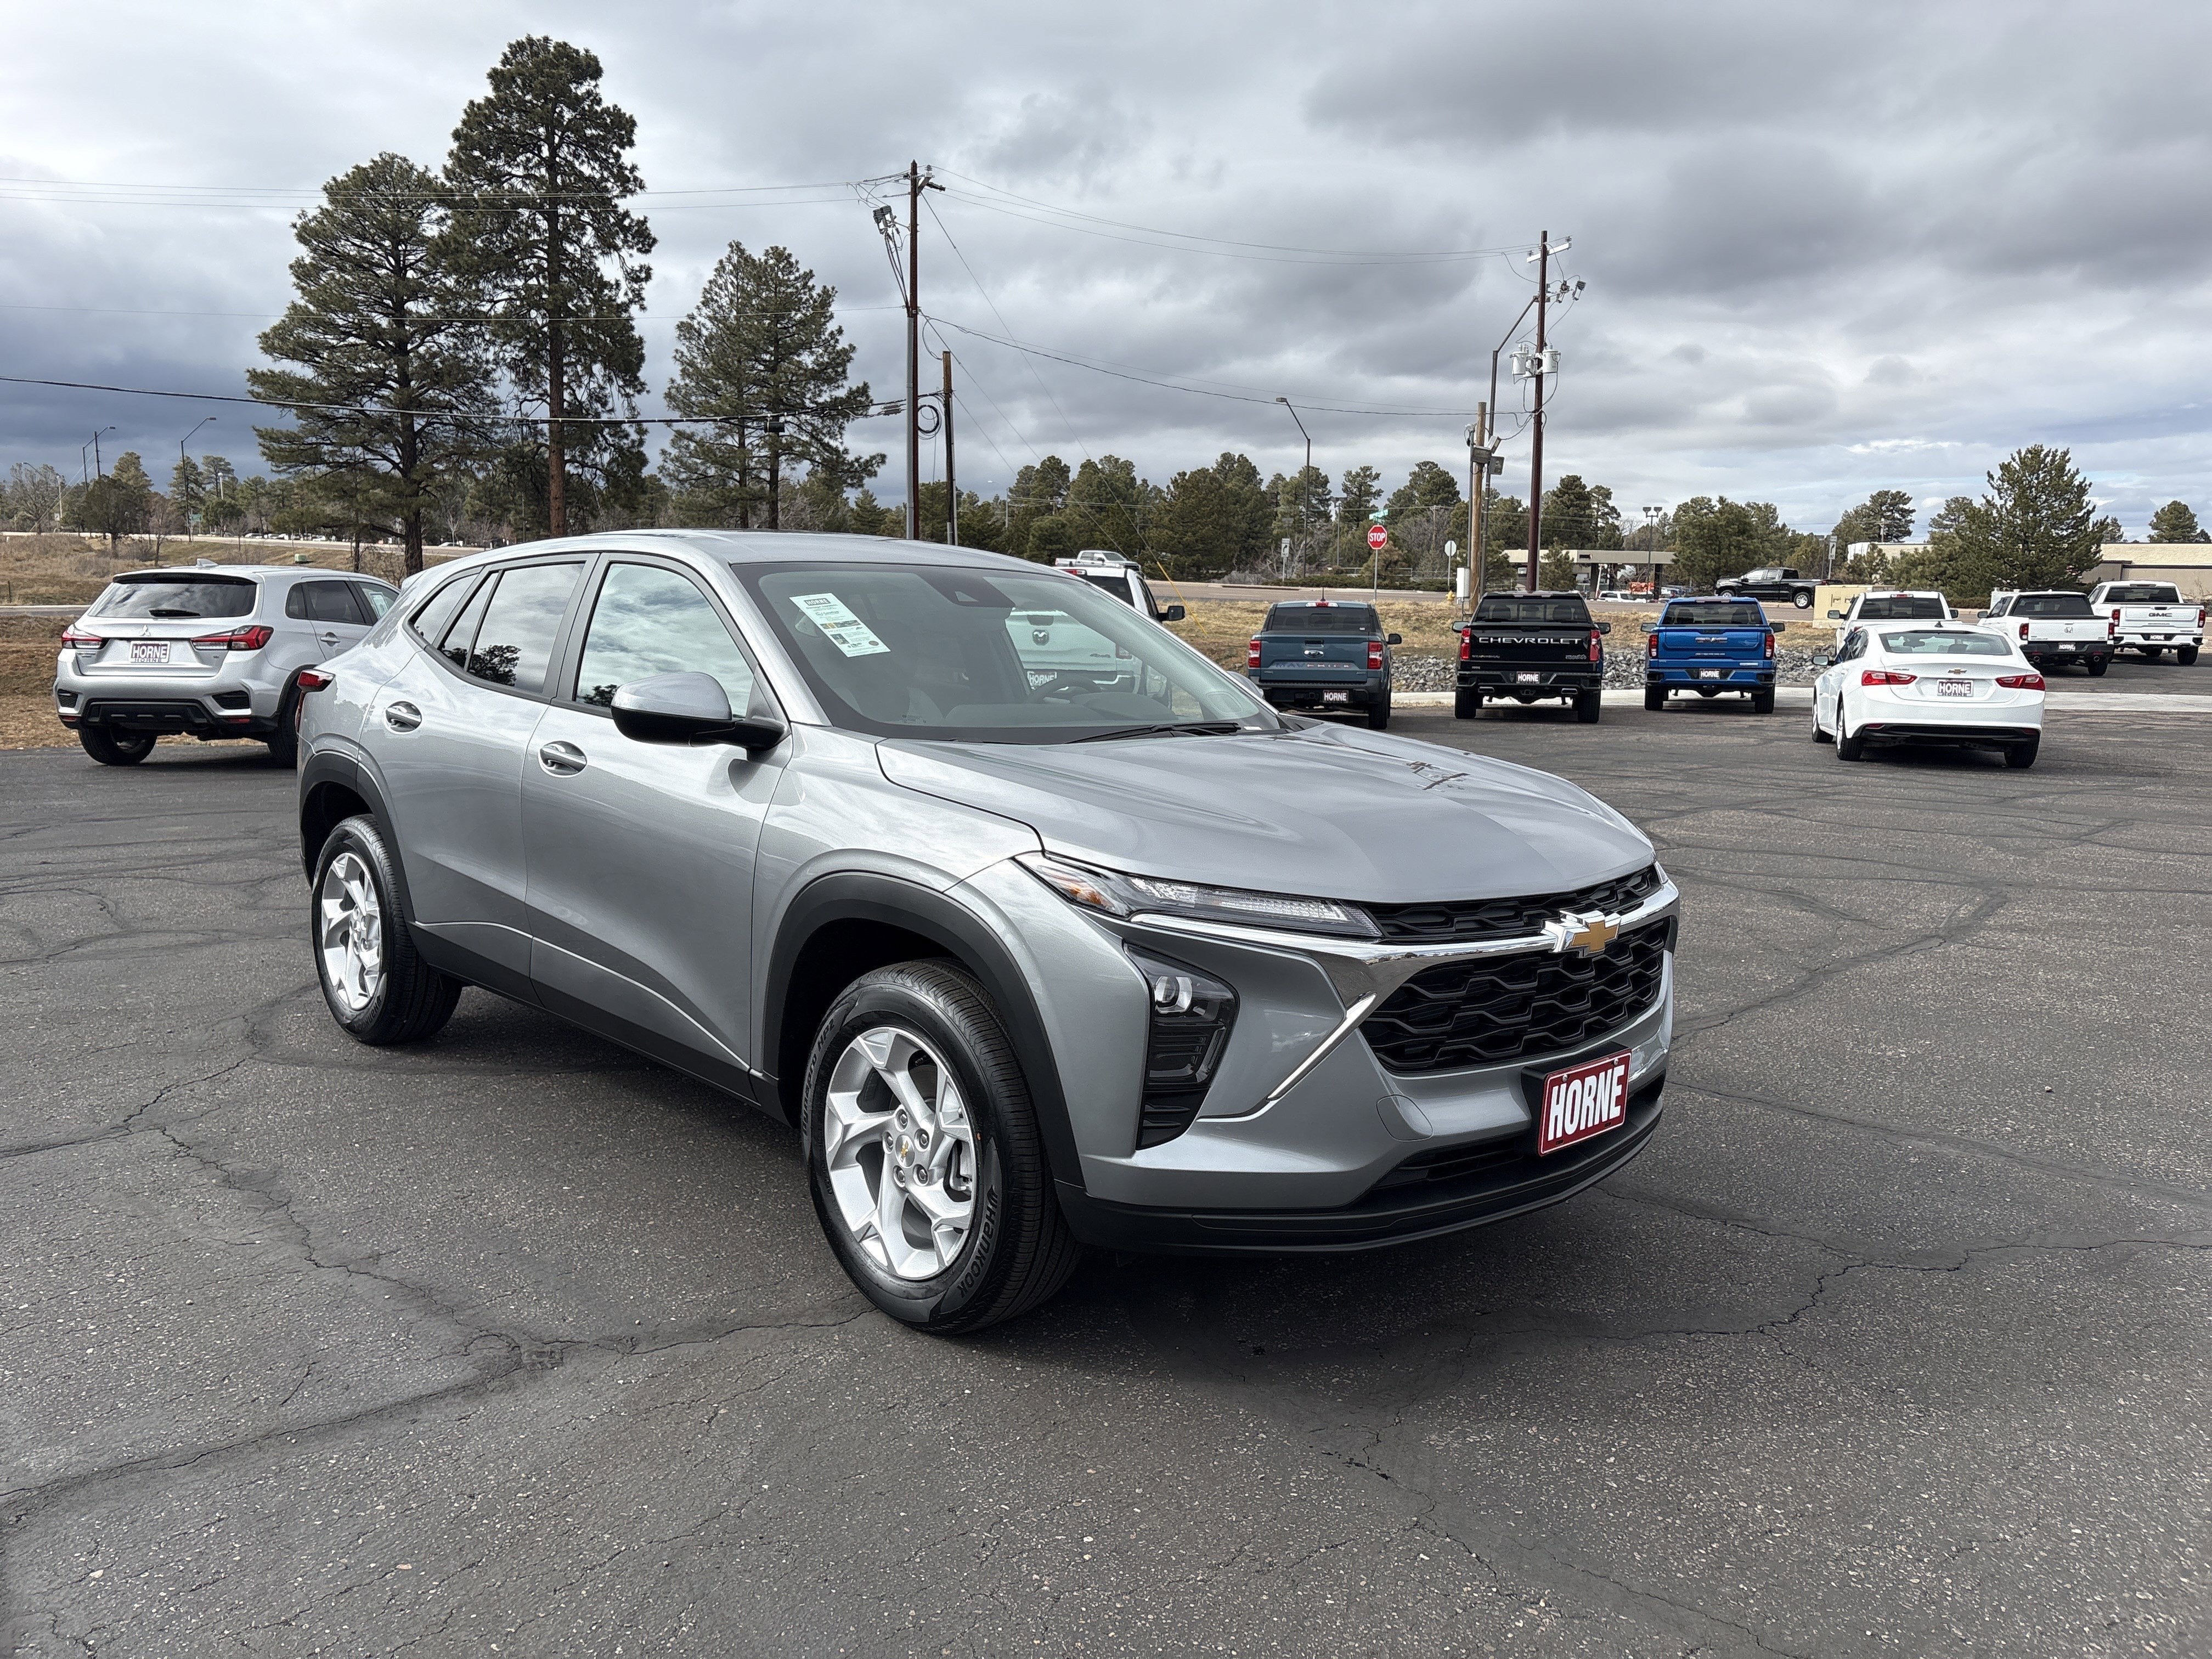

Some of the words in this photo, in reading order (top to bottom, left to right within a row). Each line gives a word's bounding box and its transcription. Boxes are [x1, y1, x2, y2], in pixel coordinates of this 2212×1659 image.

[1369, 532, 1386, 542] STOP
[1479, 636, 1582, 645] CHEVROLET
[132, 645, 167, 658] HORNE
[1517, 673, 1539, 682] HORNE
[1938, 682, 1971, 694] HORNE
[1323, 691, 1347, 701] HORNE
[1547, 1064, 1625, 1142] HORNE
